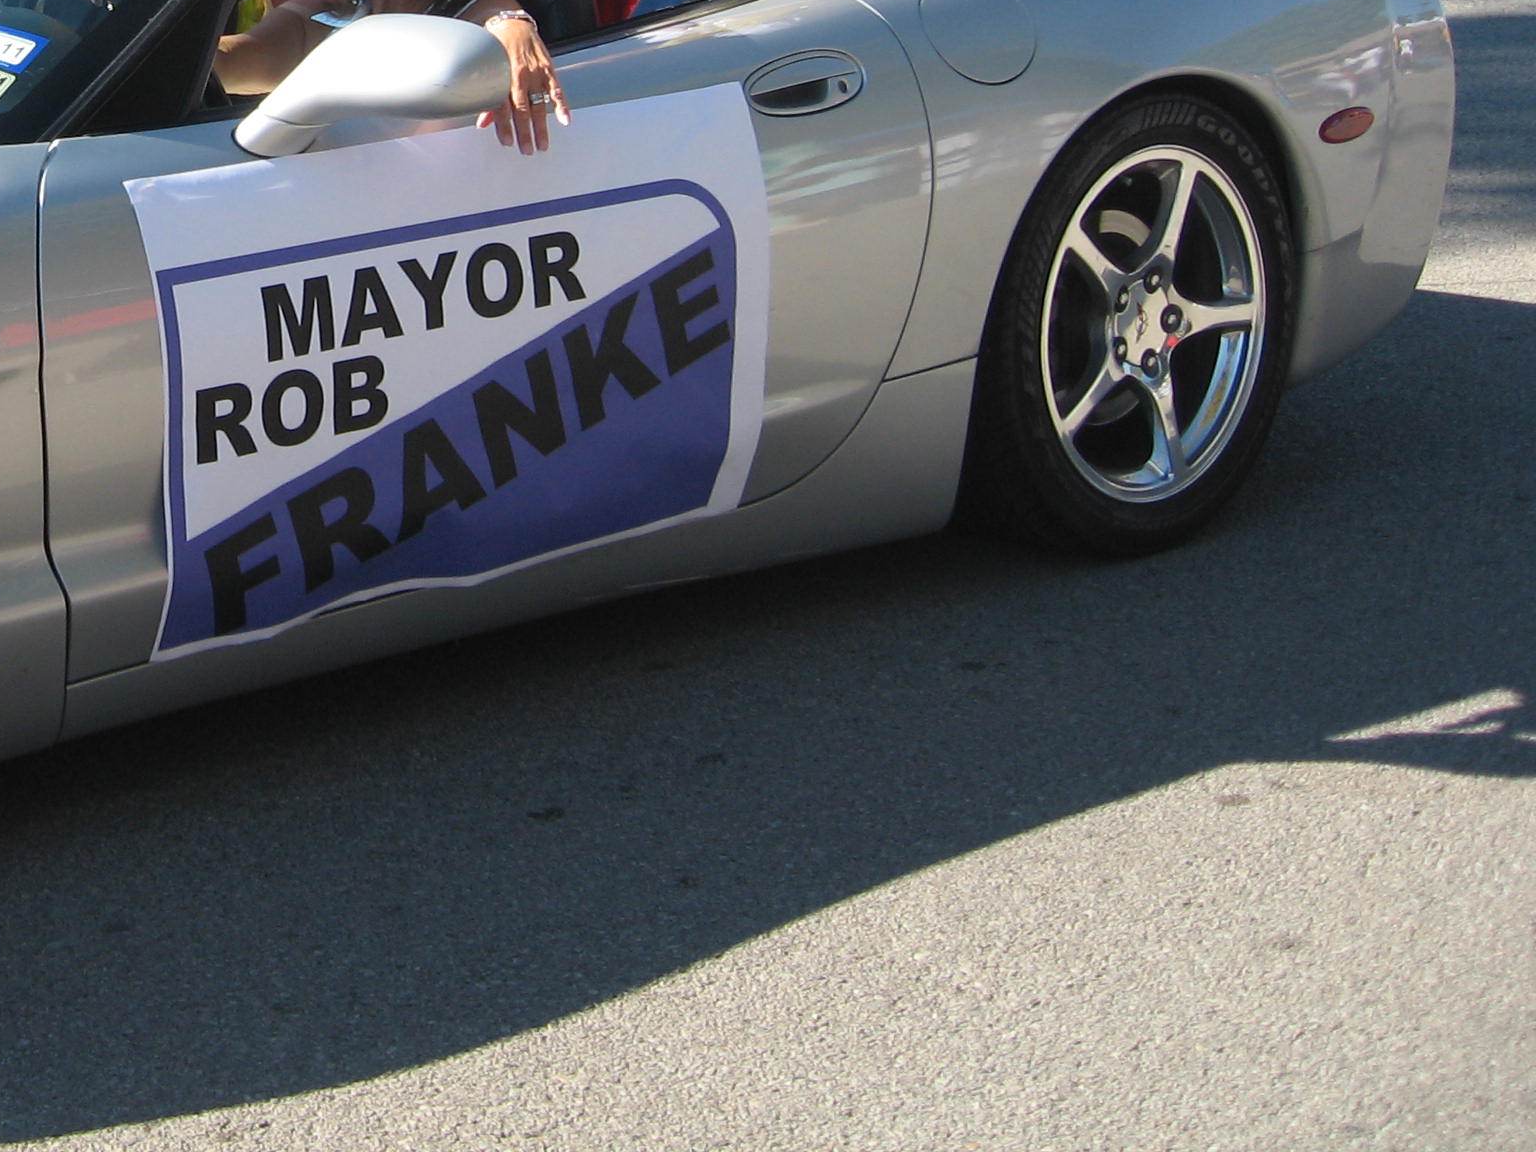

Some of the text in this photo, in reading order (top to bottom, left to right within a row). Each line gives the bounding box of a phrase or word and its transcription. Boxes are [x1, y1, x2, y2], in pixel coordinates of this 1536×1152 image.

[261, 230, 587, 363] MAYOR
[195, 354, 389, 465] ROB
[203, 246, 732, 638] FRANKE
